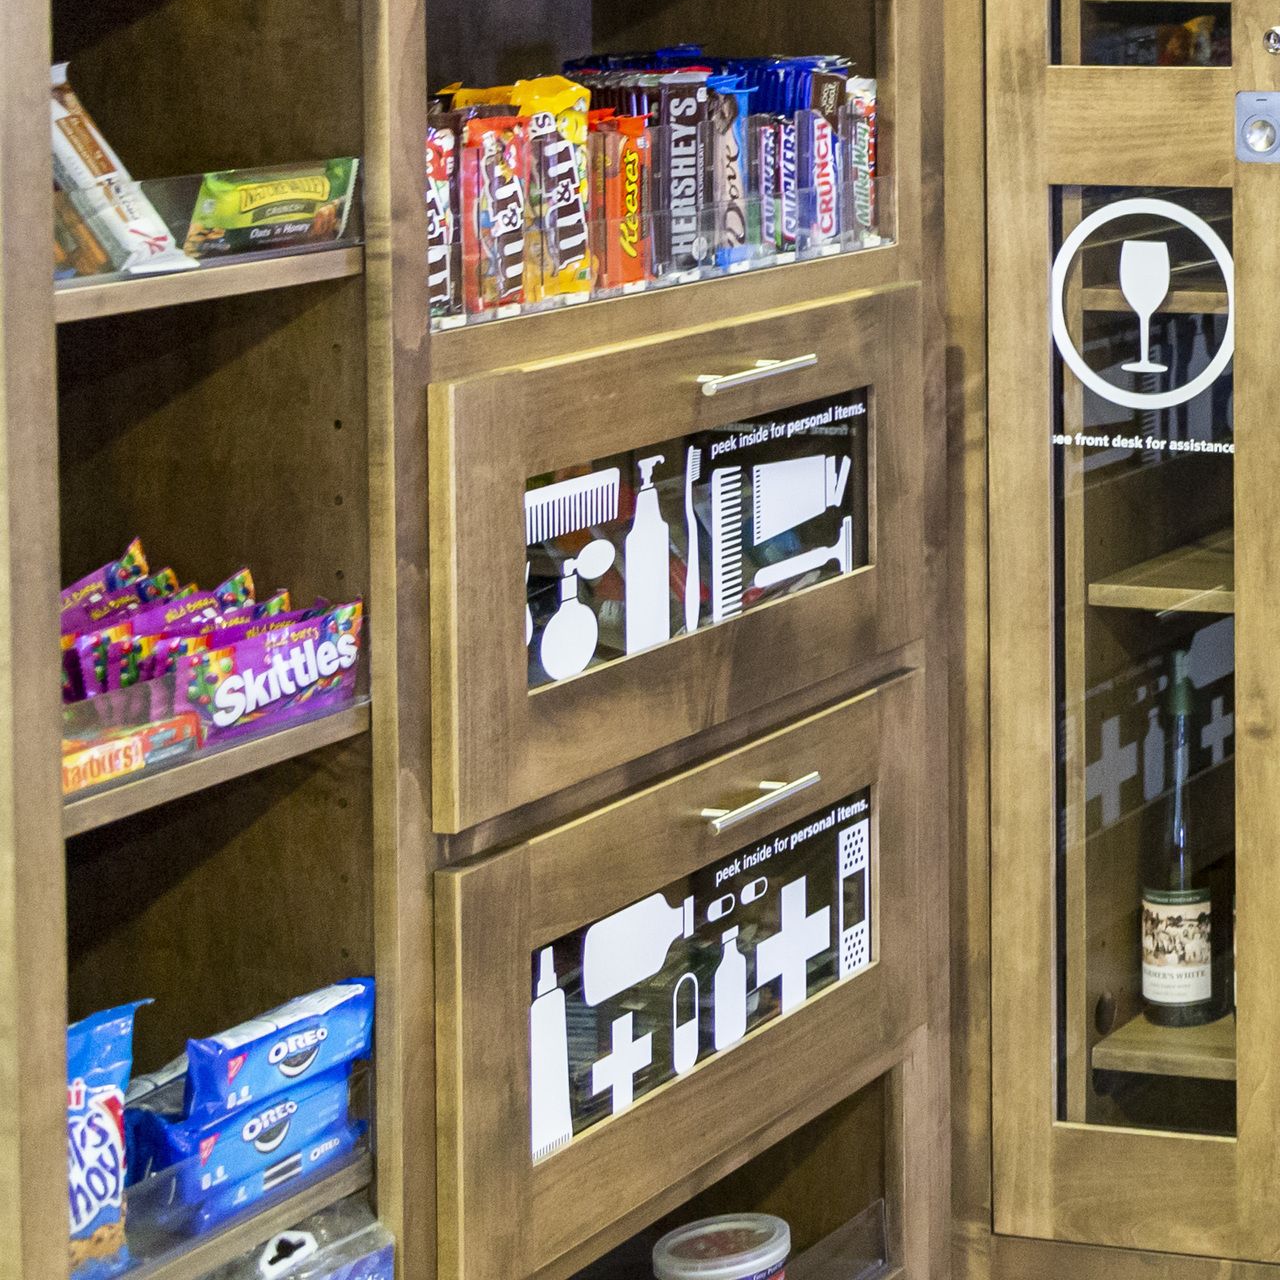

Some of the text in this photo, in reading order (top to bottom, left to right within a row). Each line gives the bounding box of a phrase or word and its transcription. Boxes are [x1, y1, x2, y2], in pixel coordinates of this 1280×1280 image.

[671, 97, 698, 256] HERSHEY'S
[814, 121, 833, 234] CRUNCH
[283, 223, 311, 235] Honey
[711, 402, 867, 459] peek inside for personal items.
[1075, 432, 1110, 448] front
[1111, 433, 1144, 450] desk
[1146, 435, 1167, 451] for
[1168, 437, 1235, 454] assistance
[213, 634, 359, 728] Skittles
[715, 798, 869, 887] peek inside for personal items.
[268, 1027, 328, 1064] OREO
[242, 1101, 298, 1142] OREO
[310, 1138, 340, 1161] OREO
